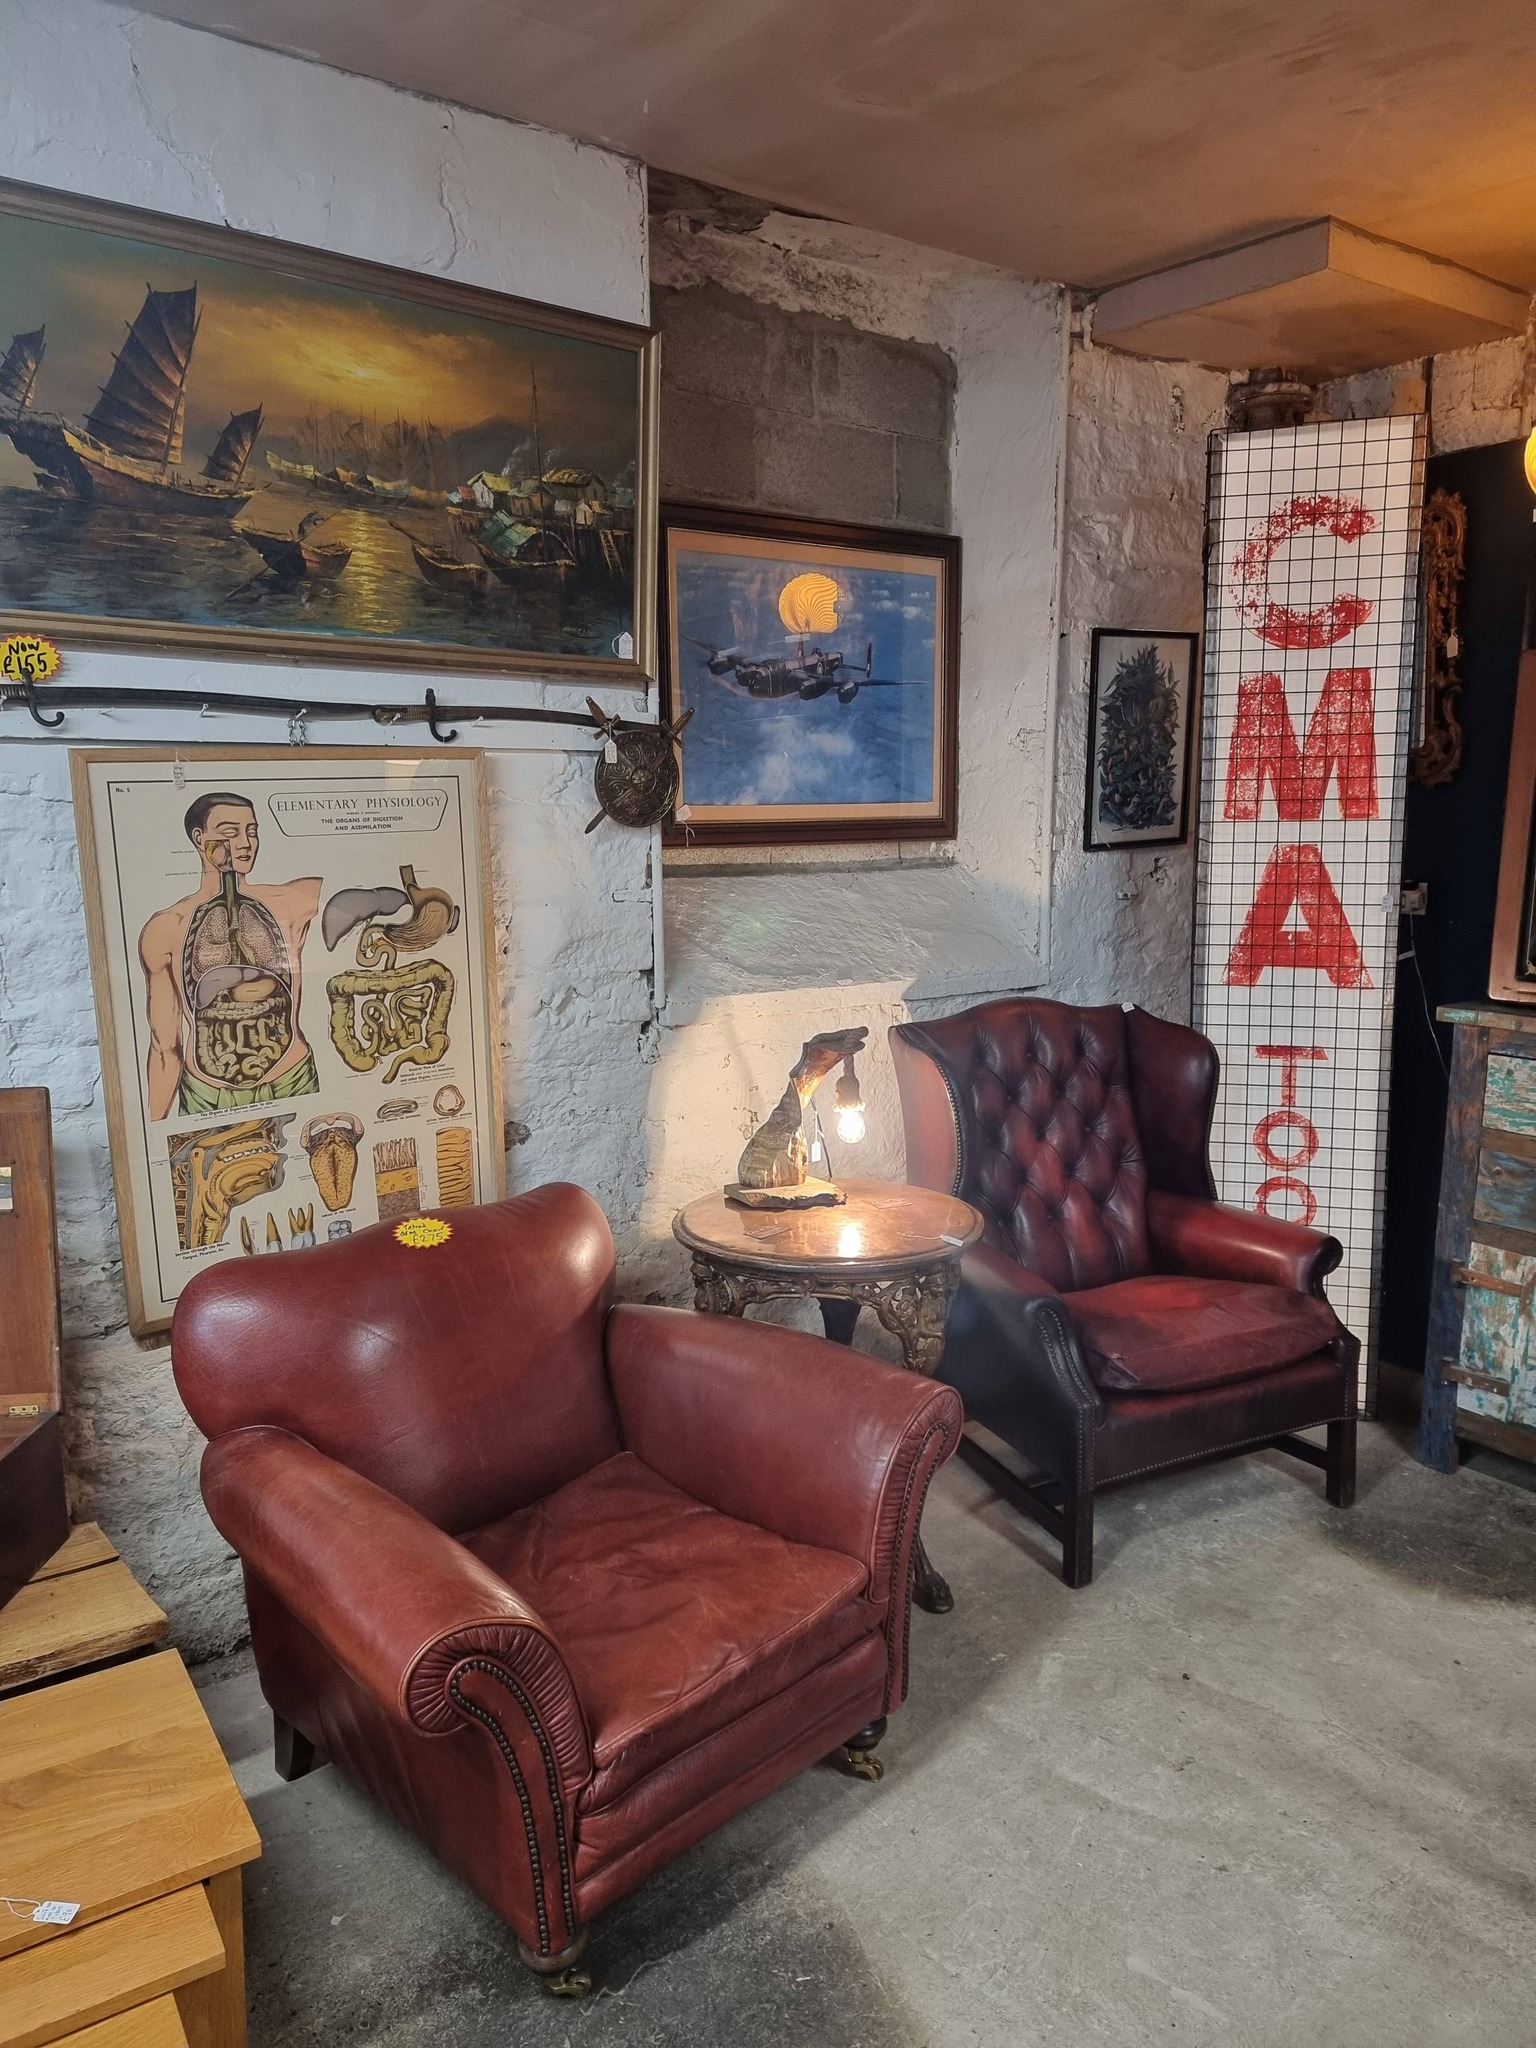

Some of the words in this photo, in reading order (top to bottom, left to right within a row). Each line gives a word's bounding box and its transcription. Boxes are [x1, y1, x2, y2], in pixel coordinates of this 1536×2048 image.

[3, 652, 47, 676] £155
[276, 799, 359, 812] ELEMENTARY
[366, 796, 443, 809] PHYSIOLOGY
[412, 1231, 443, 1244] £275
